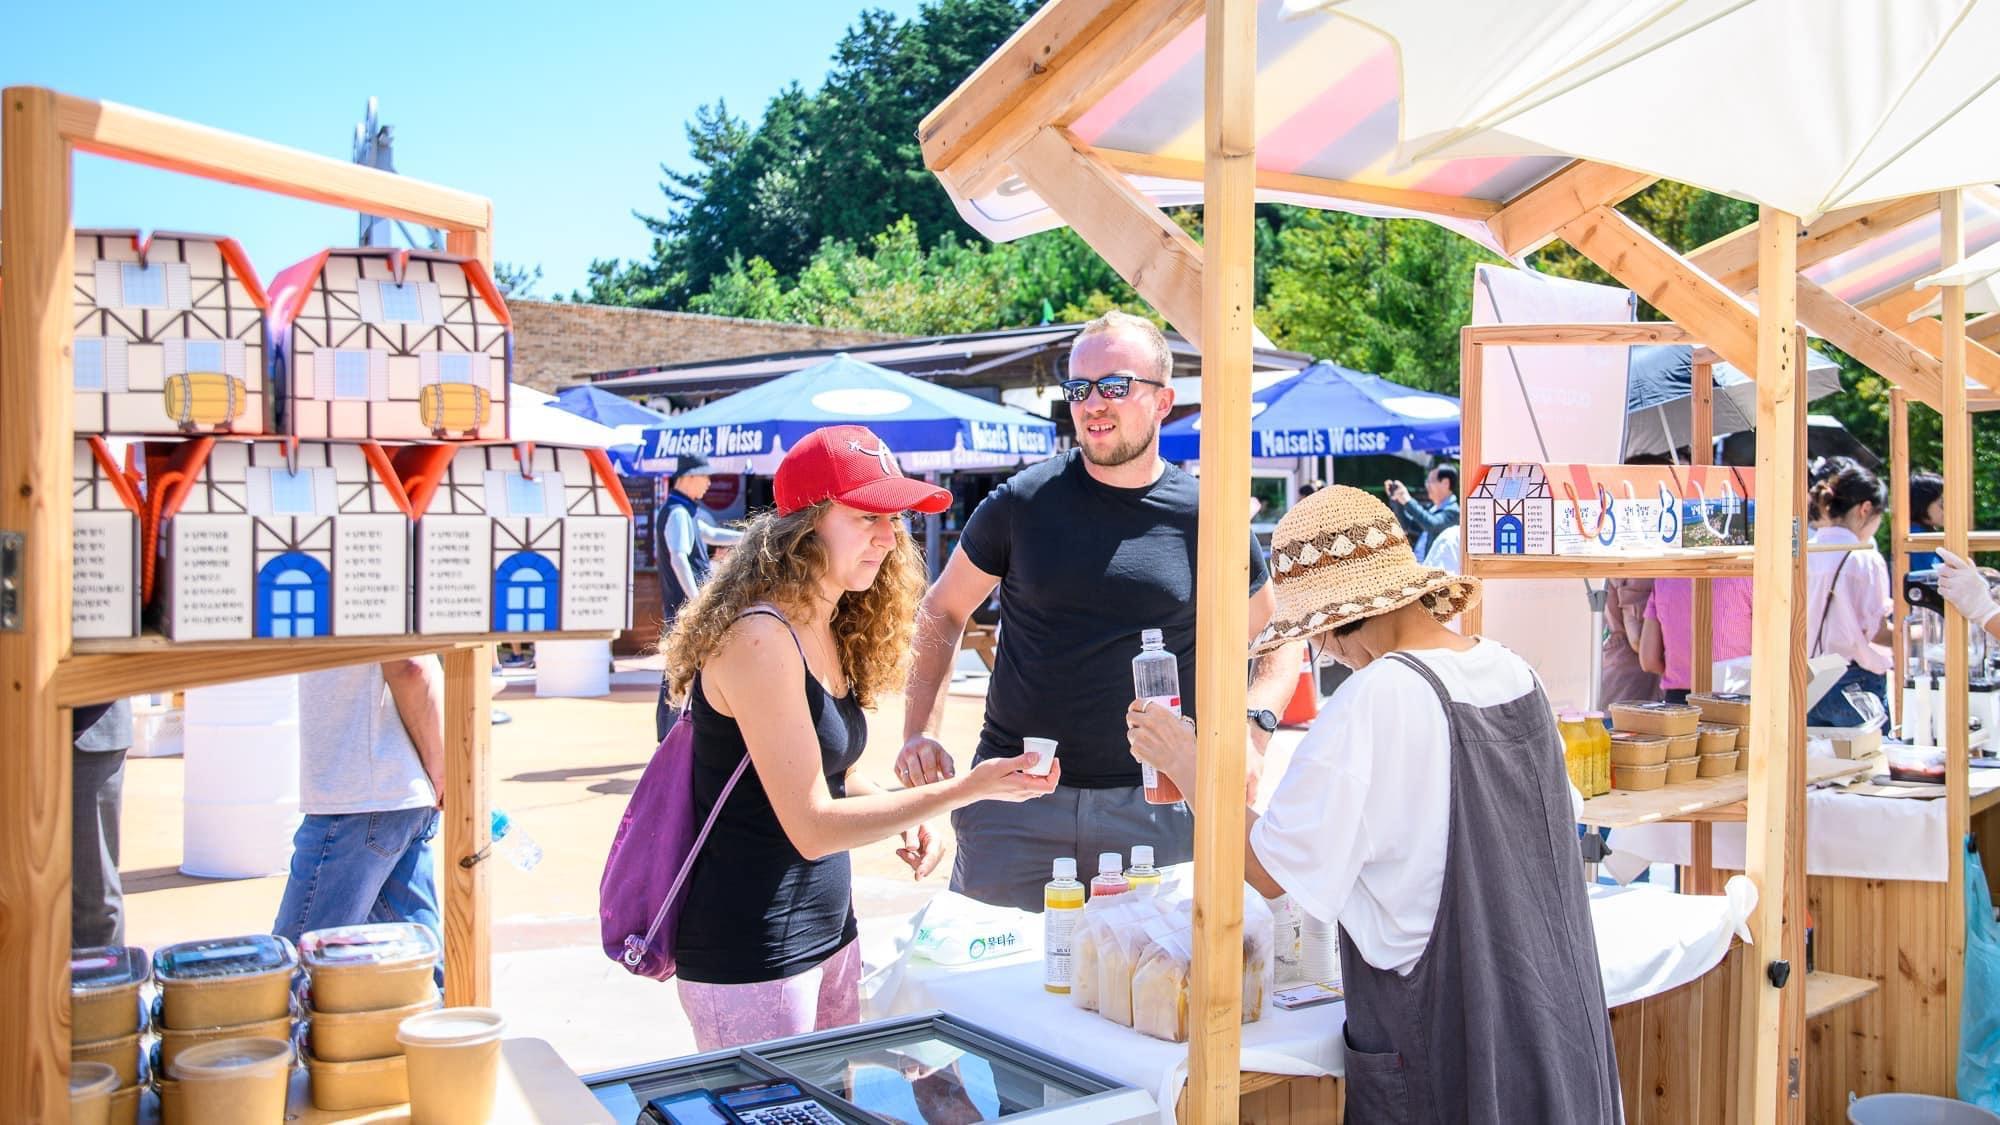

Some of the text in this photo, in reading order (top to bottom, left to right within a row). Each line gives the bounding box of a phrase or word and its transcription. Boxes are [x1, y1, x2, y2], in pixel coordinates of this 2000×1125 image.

[655, 424, 762, 457] Maisel's Weisse
[1259, 426, 1387, 456] Maisel's Weisse
